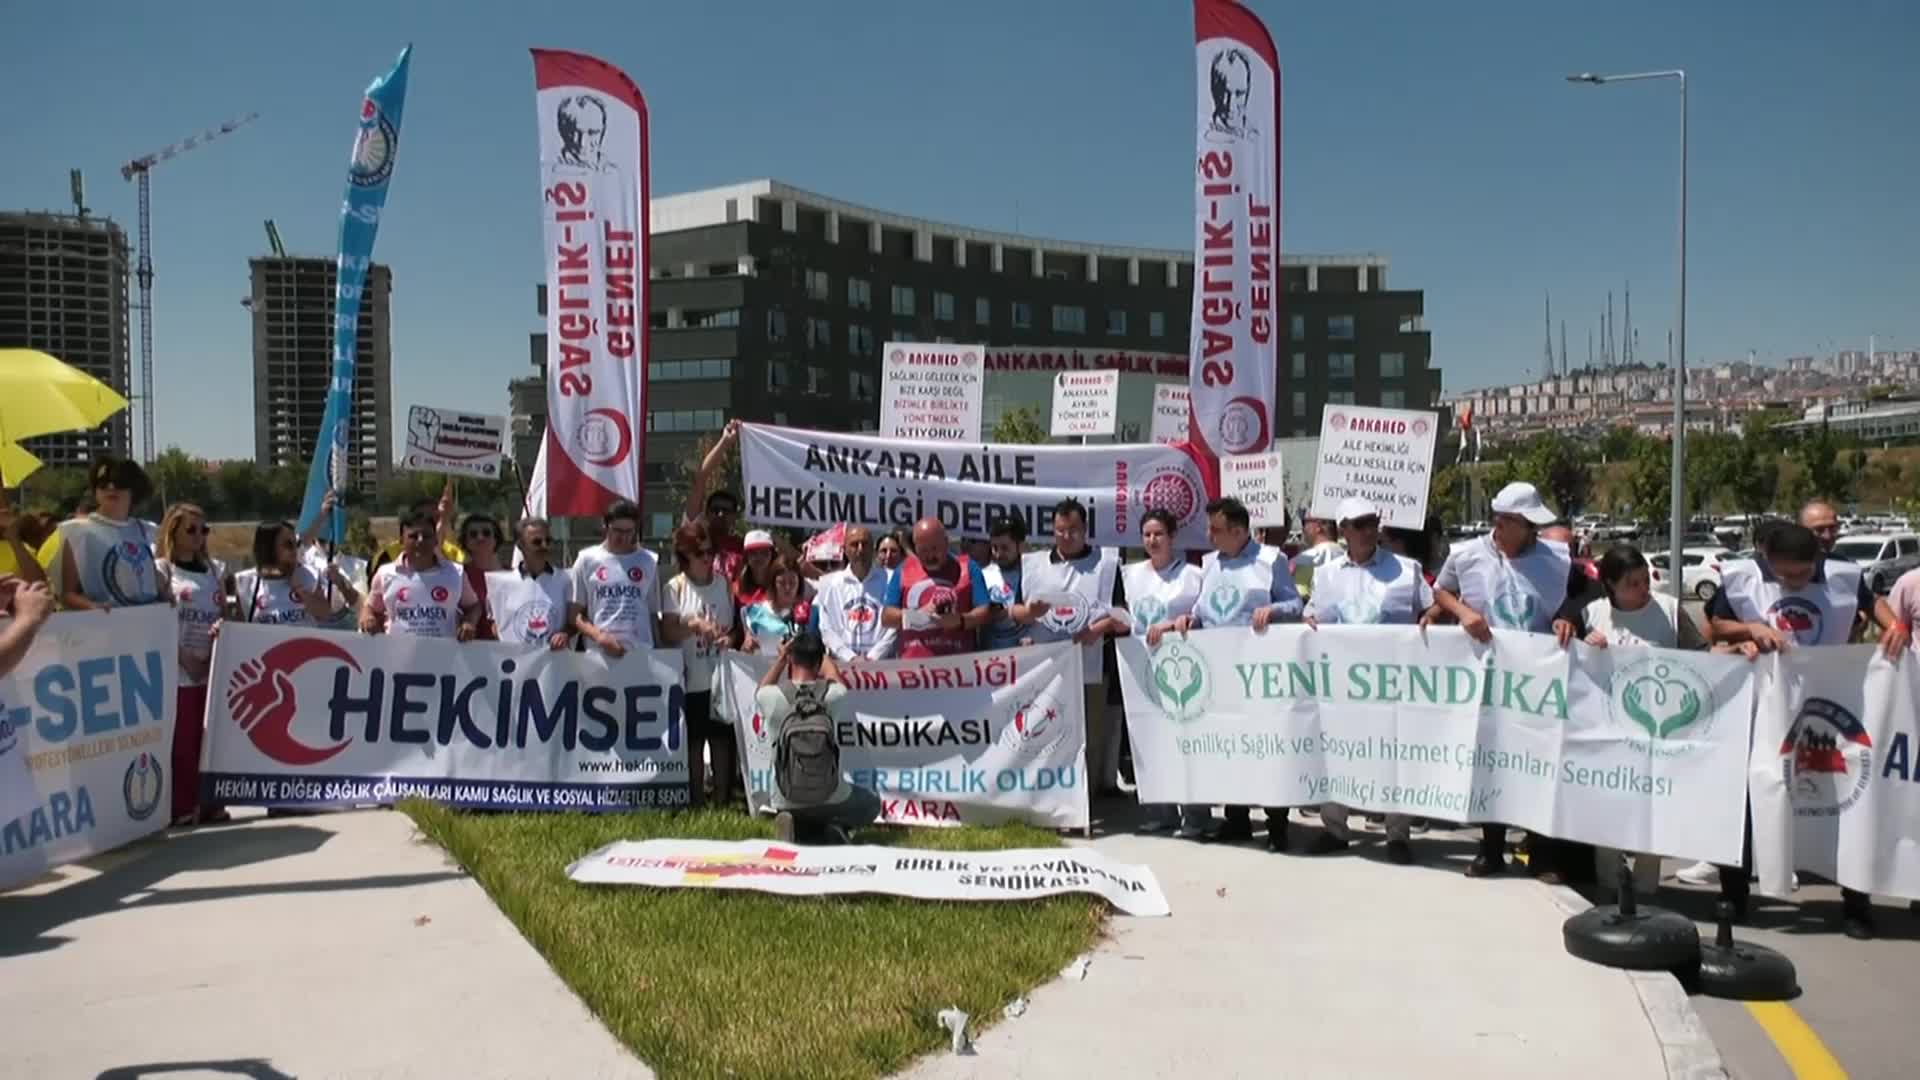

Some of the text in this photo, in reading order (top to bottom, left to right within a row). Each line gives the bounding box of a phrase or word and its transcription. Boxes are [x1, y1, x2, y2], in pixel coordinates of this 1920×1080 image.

[984, 351, 1067, 371] ANKARA
[1073, 350, 1089, 370] İL
[803, 443, 1036, 486] ANKARA AİLE
[750, 482, 1096, 539] HEKİMLİĞİ DERNEİ
[901, 655, 1018, 690] BİRLİĞİ
[1235, 653, 1333, 700] YENİ
[1347, 657, 1570, 721] SENDİKA
[328, 659, 688, 751] HEKİMSEN
[838, 715, 991, 748] ENDİKASI
[897, 767, 987, 793] BİRLİK
[996, 767, 1076, 792] OLDU
[1292, 737, 1314, 753] ve
[1319, 732, 1373, 768] Sosyal
[1379, 738, 1449, 764] hizmet
[1454, 743, 1555, 780] Çalışanları
[1562, 759, 1673, 798] Sendikası
[215, 777, 257, 798] HEKİM
[261, 781, 277, 798] VE
[280, 778, 321, 799] DİĞER
[325, 779, 370, 800] SAĞLIK
[373, 782, 451, 801] ÇALIŞANLARI
[455, 785, 489, 803] KAMU
[492, 784, 533, 805] SAĞLIK
[536, 788, 551, 804] VE
[553, 789, 595, 806] SOSYAL
